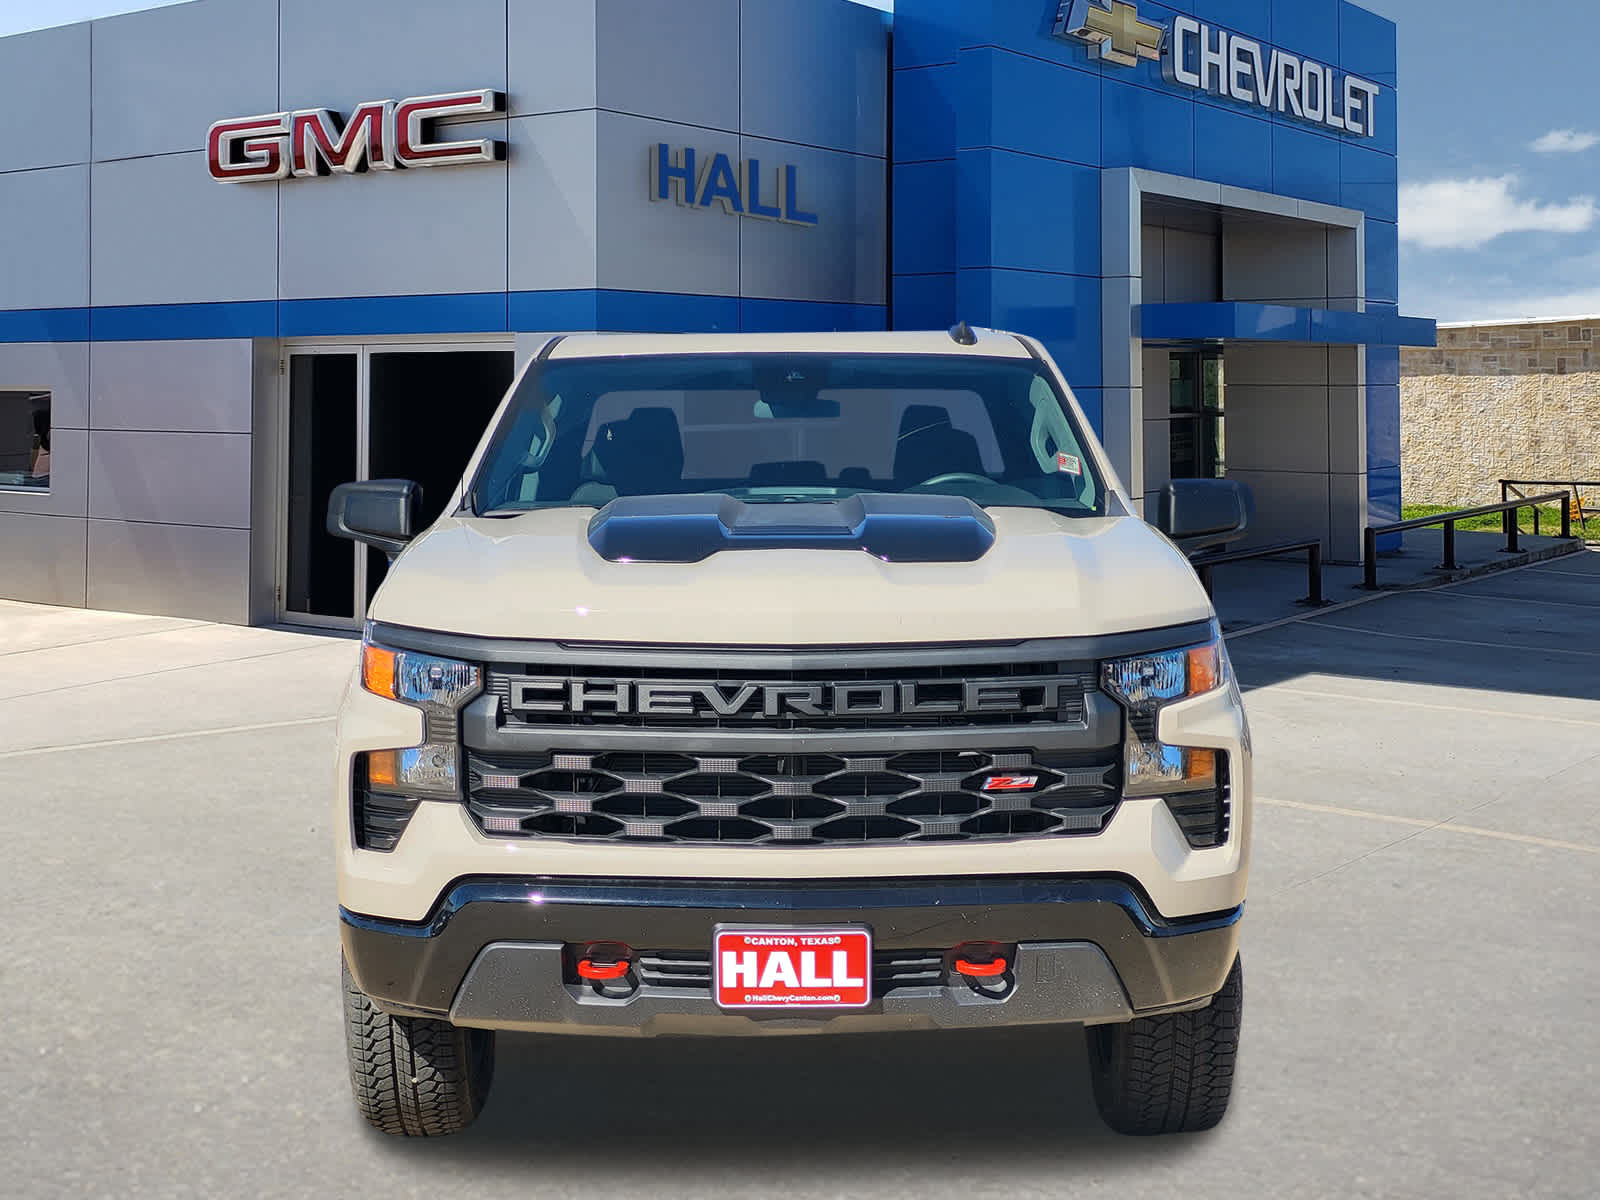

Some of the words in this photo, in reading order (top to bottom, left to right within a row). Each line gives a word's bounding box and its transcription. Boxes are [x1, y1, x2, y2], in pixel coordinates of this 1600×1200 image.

[1172, 14, 1380, 137] CHEVROLET
[207, 88, 507, 184] GMC
[655, 142, 817, 226] HALL
[508, 678, 1078, 718] CHEVROLET
[722, 951, 864, 988] HALL
[751, 937, 798, 947] CANTON,
[800, 937, 834, 945] TEXAS
